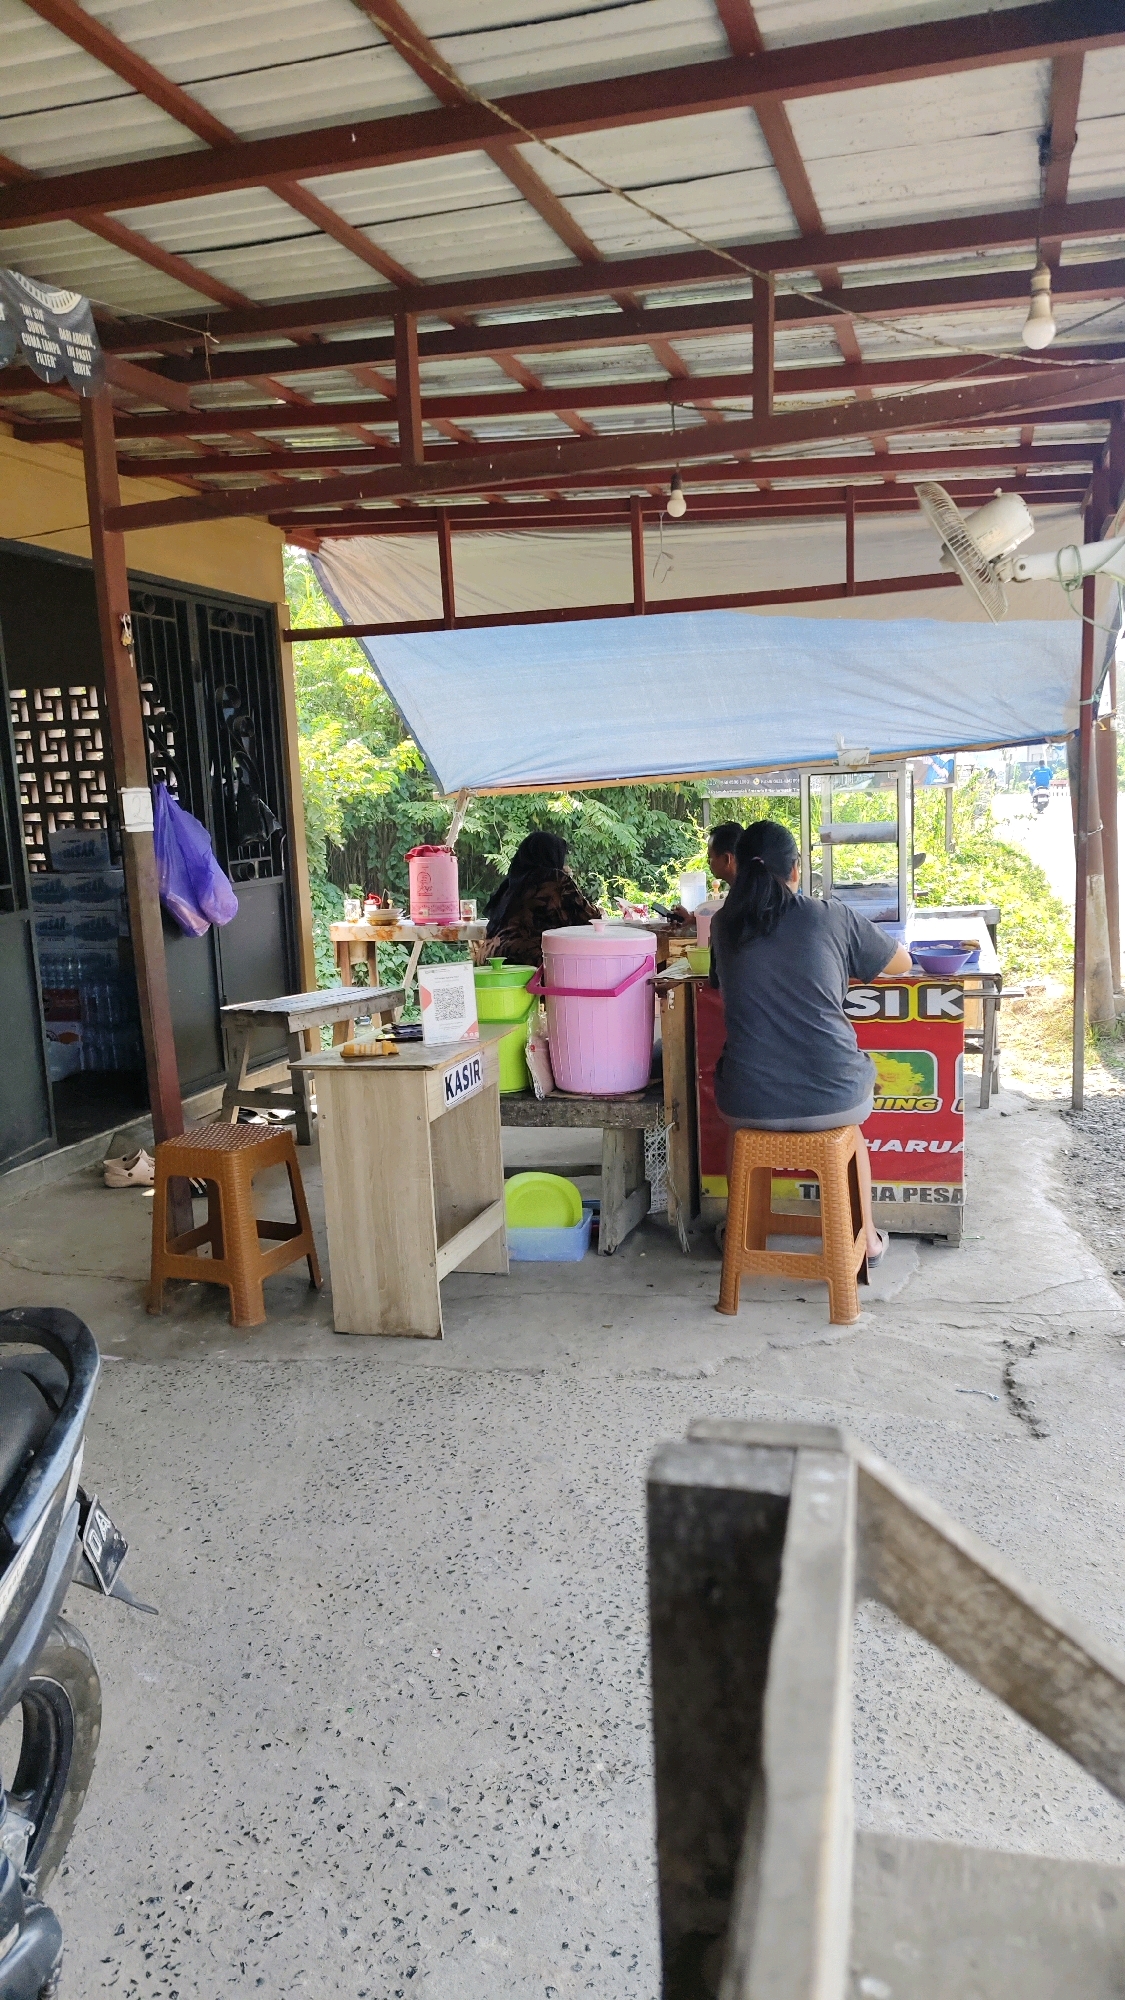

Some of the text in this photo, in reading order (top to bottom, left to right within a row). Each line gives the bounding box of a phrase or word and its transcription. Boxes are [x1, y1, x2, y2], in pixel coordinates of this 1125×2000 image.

[843, 988, 900, 1017] SI
[444, 1058, 481, 1101] KASIR
[873, 1098, 939, 1112] NING
[87, 1509, 113, 1563] DA
